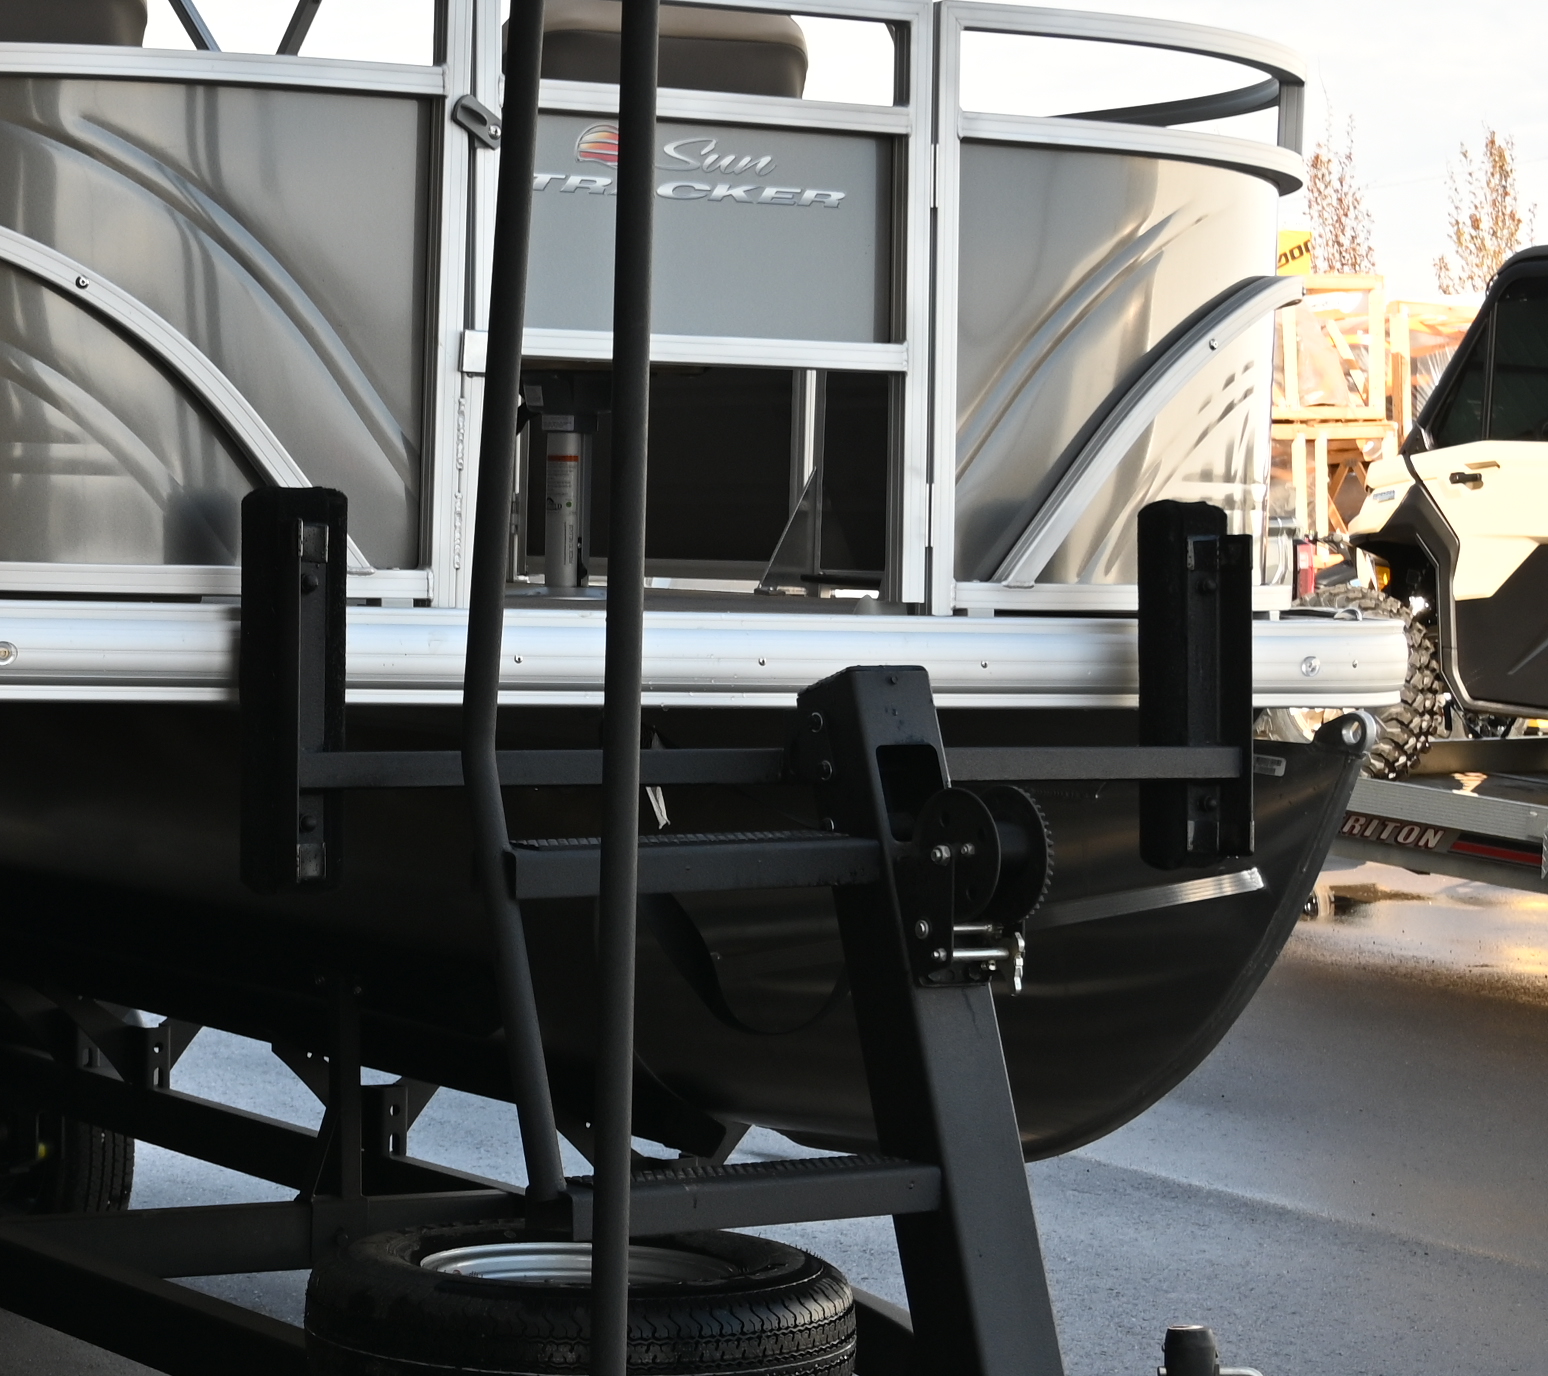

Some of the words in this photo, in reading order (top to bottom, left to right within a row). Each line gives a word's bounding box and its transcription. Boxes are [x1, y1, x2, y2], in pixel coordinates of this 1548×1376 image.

[654, 137, 776, 176] Sun
[533, 173, 847, 209] TRCKER
[1341, 815, 1445, 848] RITON
